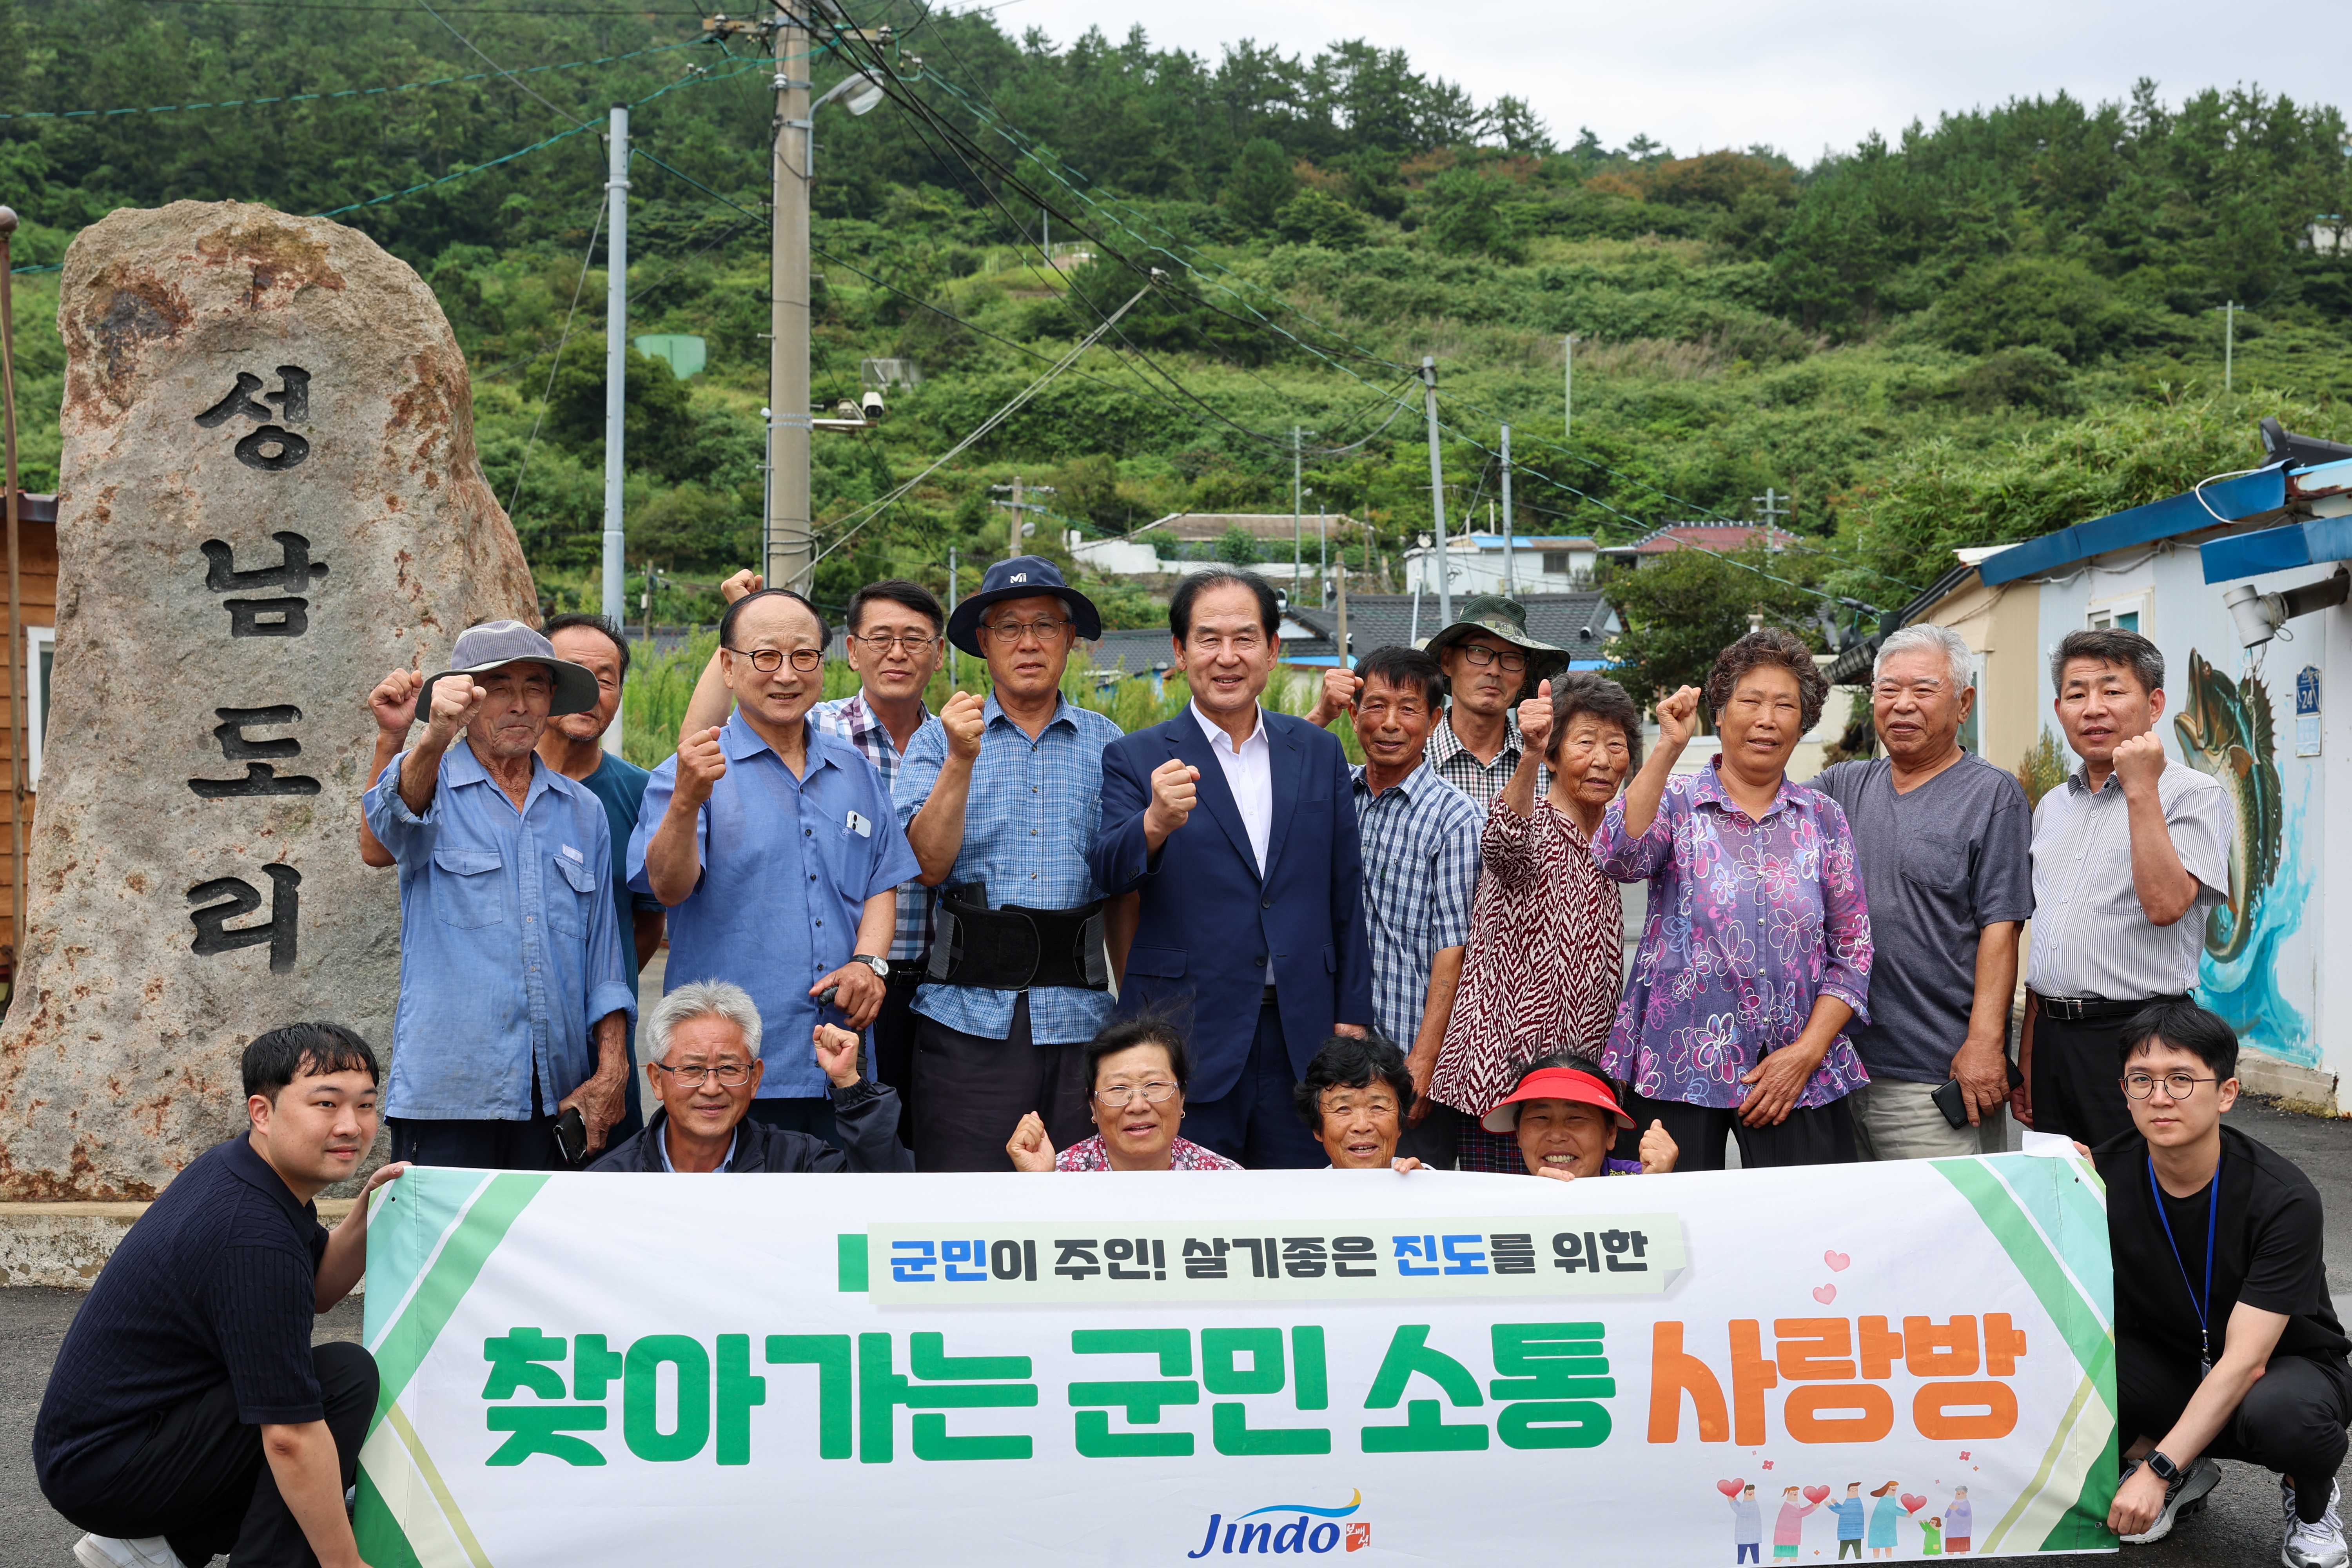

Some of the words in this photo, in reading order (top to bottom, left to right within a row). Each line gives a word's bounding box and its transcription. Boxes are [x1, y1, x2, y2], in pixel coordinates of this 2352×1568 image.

[187, 365, 329, 974] 성남도리
[1519, 679, 1528, 699] KOREA
[2301, 690, 2313, 709] 24
[891, 1240, 1037, 1282] 군민이
[1054, 1239, 1166, 1281] 주인!
[1182, 1236, 1377, 1279] 살기좋은
[1393, 1234, 1535, 1276] 진도를
[1552, 1229, 1648, 1273] 위한
[482, 1327, 1038, 1466] 찾아가는
[1068, 1326, 1331, 1458] 군민
[1361, 1322, 1616, 1453] 소통
[1648, 1313, 2026, 1446] 사랑방
[1187, 1514, 1340, 1559] Jindo
